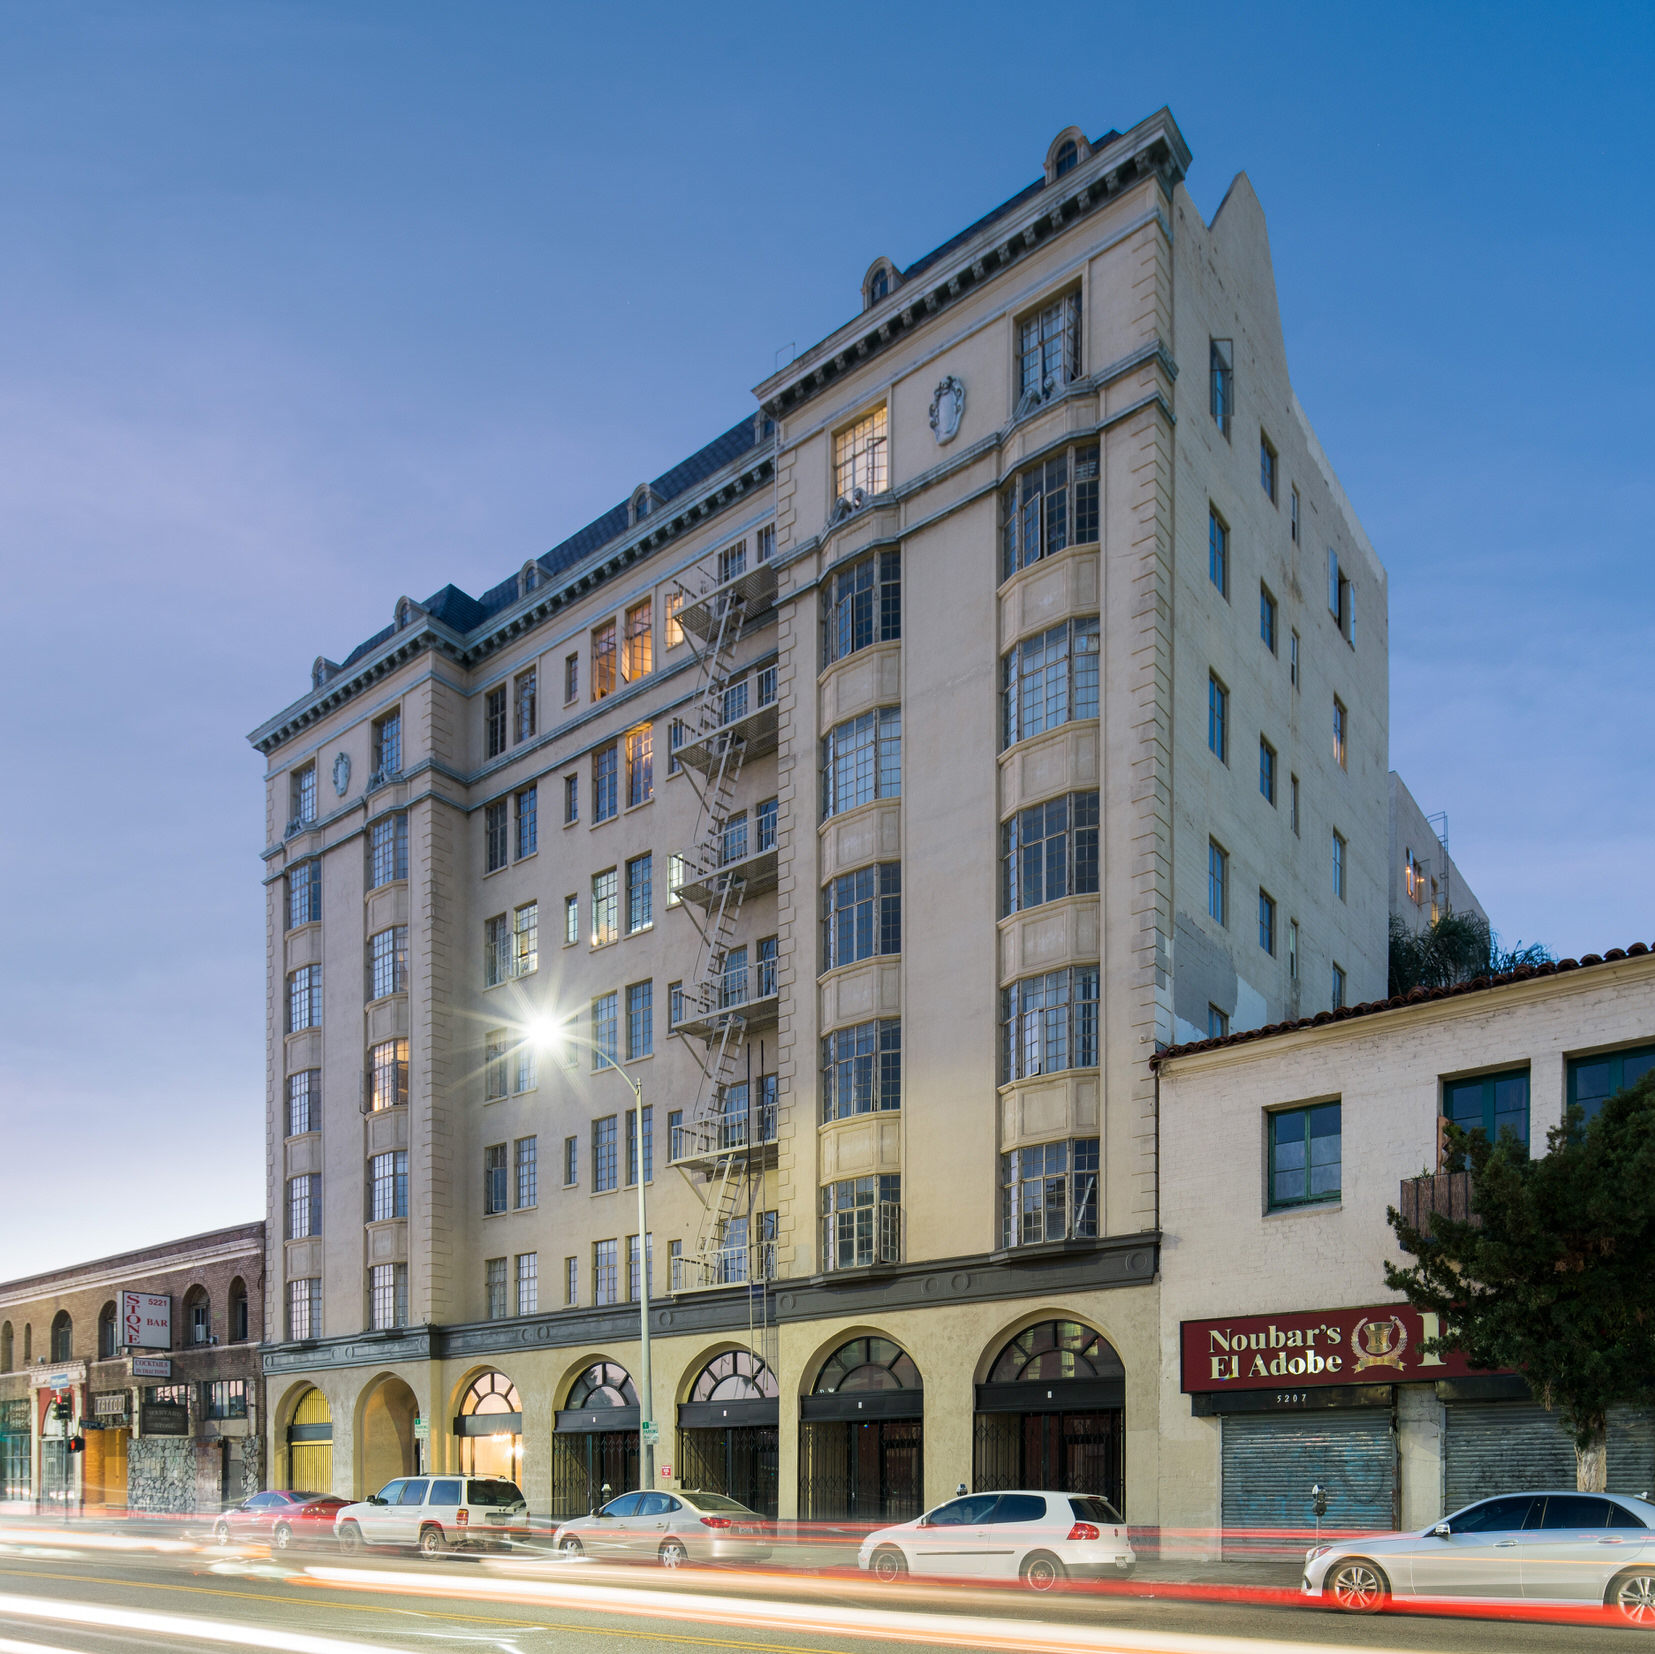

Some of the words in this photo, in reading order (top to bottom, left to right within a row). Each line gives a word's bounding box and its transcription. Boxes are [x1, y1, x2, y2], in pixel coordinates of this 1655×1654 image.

[148, 1298, 167, 1306] 5221
[126, 1295, 141, 1344] STONE
[146, 1318, 168, 1327] BAR
[1209, 1355, 1240, 1379] El
[1247, 1349, 1343, 1378] Adobe
[1277, 1393, 1307, 1403] 5207
[97, 1399, 122, 1412] TATTOO
